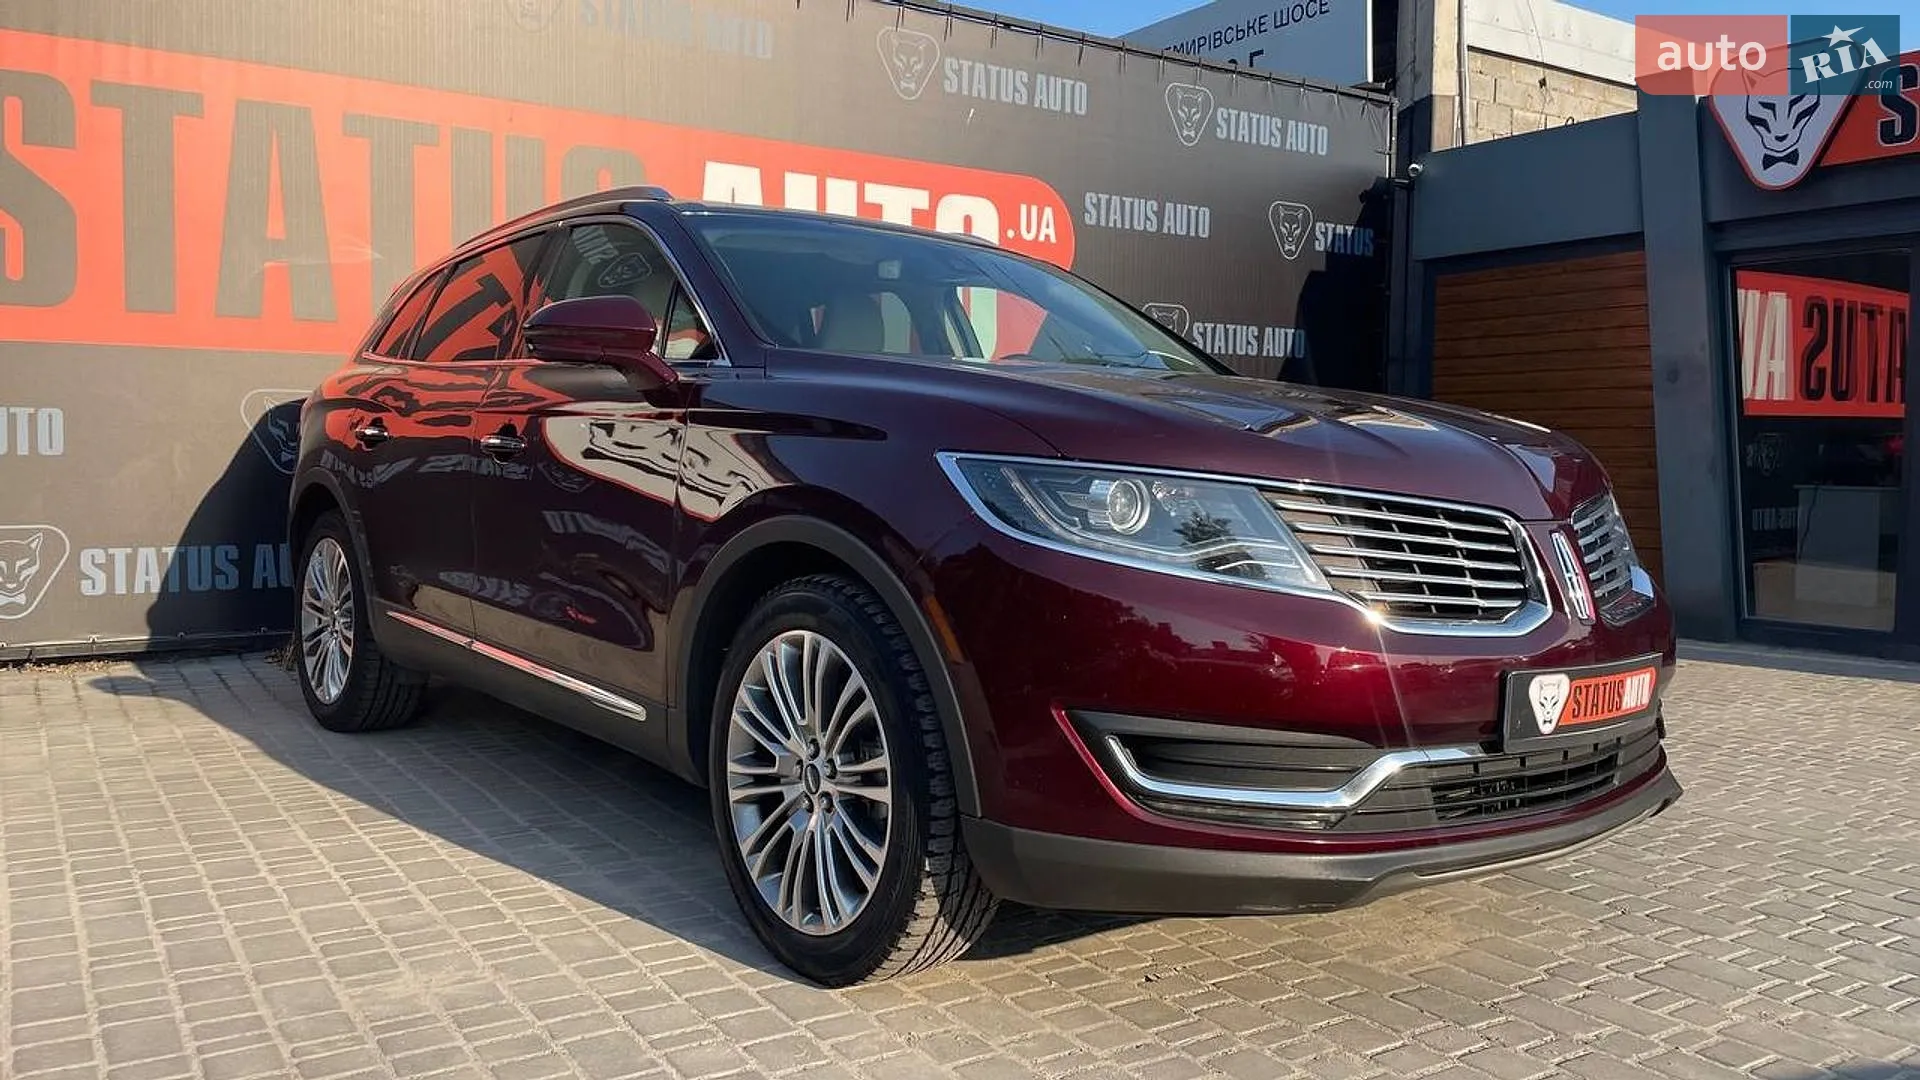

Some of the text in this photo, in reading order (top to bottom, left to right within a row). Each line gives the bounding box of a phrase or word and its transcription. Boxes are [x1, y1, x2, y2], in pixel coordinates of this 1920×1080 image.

[1163, 0, 1330, 56] МИРІВСЬКЕ ШОСЕ
[943, 57, 1088, 116] STATUS AUTO
[1216, 107, 1328, 156] STATUS AUTO
[0, 68, 648, 322] STAT
[1084, 191, 1210, 239] STATUS AUTO
[1314, 222, 1374, 257] STATUS
[1192, 322, 1306, 359] STATUS AUTO
[79, 544, 240, 597] STATUS
[1572, 672, 1651, 719] STATUS AUTO
